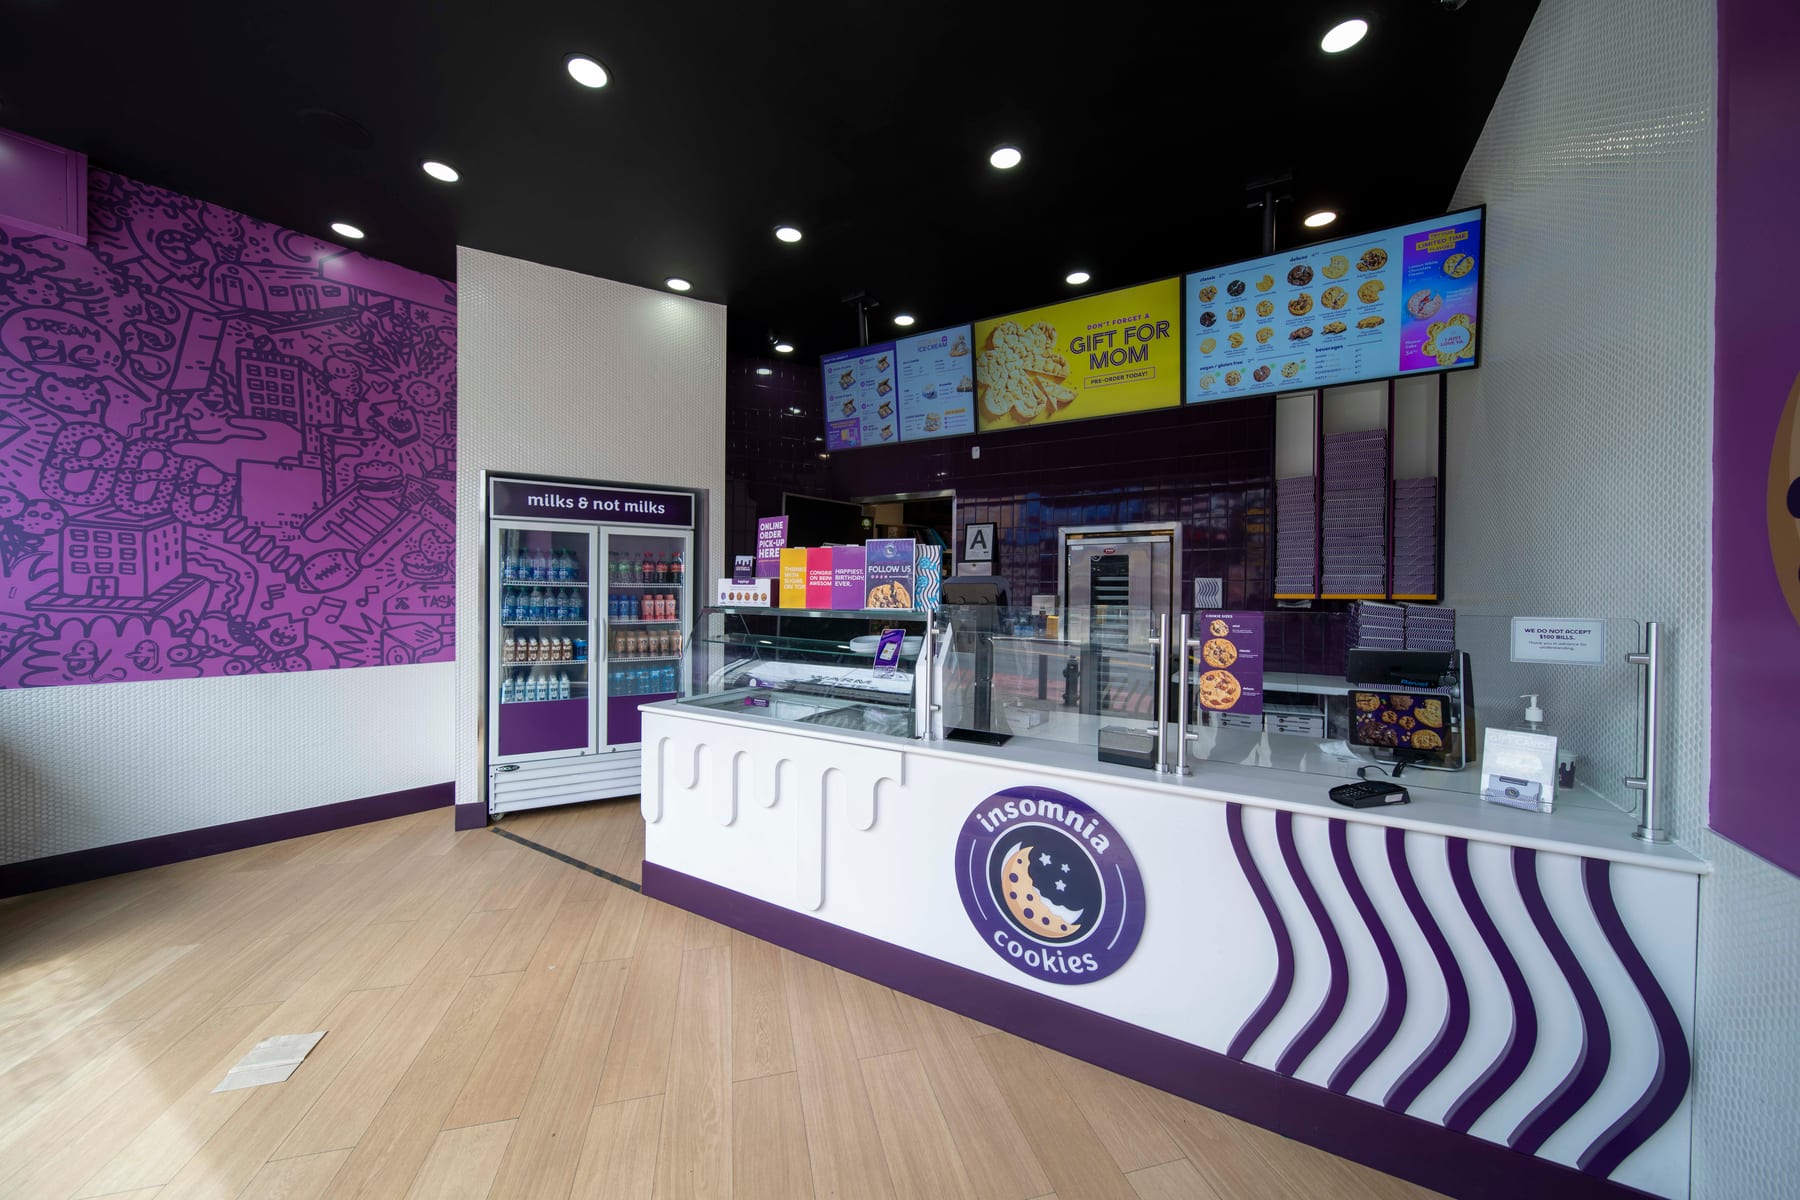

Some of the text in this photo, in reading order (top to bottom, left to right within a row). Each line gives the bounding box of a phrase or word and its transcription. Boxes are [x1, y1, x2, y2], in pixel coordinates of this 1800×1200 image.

[1417, 233, 1467, 249] LIMITED TIME
[23, 316, 101, 343] DREAM
[1087, 320, 1110, 331] DON'T
[1112, 314, 1142, 326] FORGET
[1069, 320, 1170, 355] GIFT FOR
[19, 335, 101, 365] BIG
[1089, 344, 1149, 370] MOM
[1315, 344, 1343, 353] beverages
[1090, 370, 1149, 385] PRE-ORDER TODAY!
[527, 493, 666, 514] milks & not milks
[759, 530, 782, 540] ORDER
[760, 521, 784, 532] ONLINE
[759, 538, 785, 548] PICK-UP
[970, 529, 987, 550] A
[758, 547, 780, 559] HERE
[868, 565, 912, 573] FOLLOW US
[976, 798, 1110, 855] insomnia
[993, 930, 1099, 974] cookies
